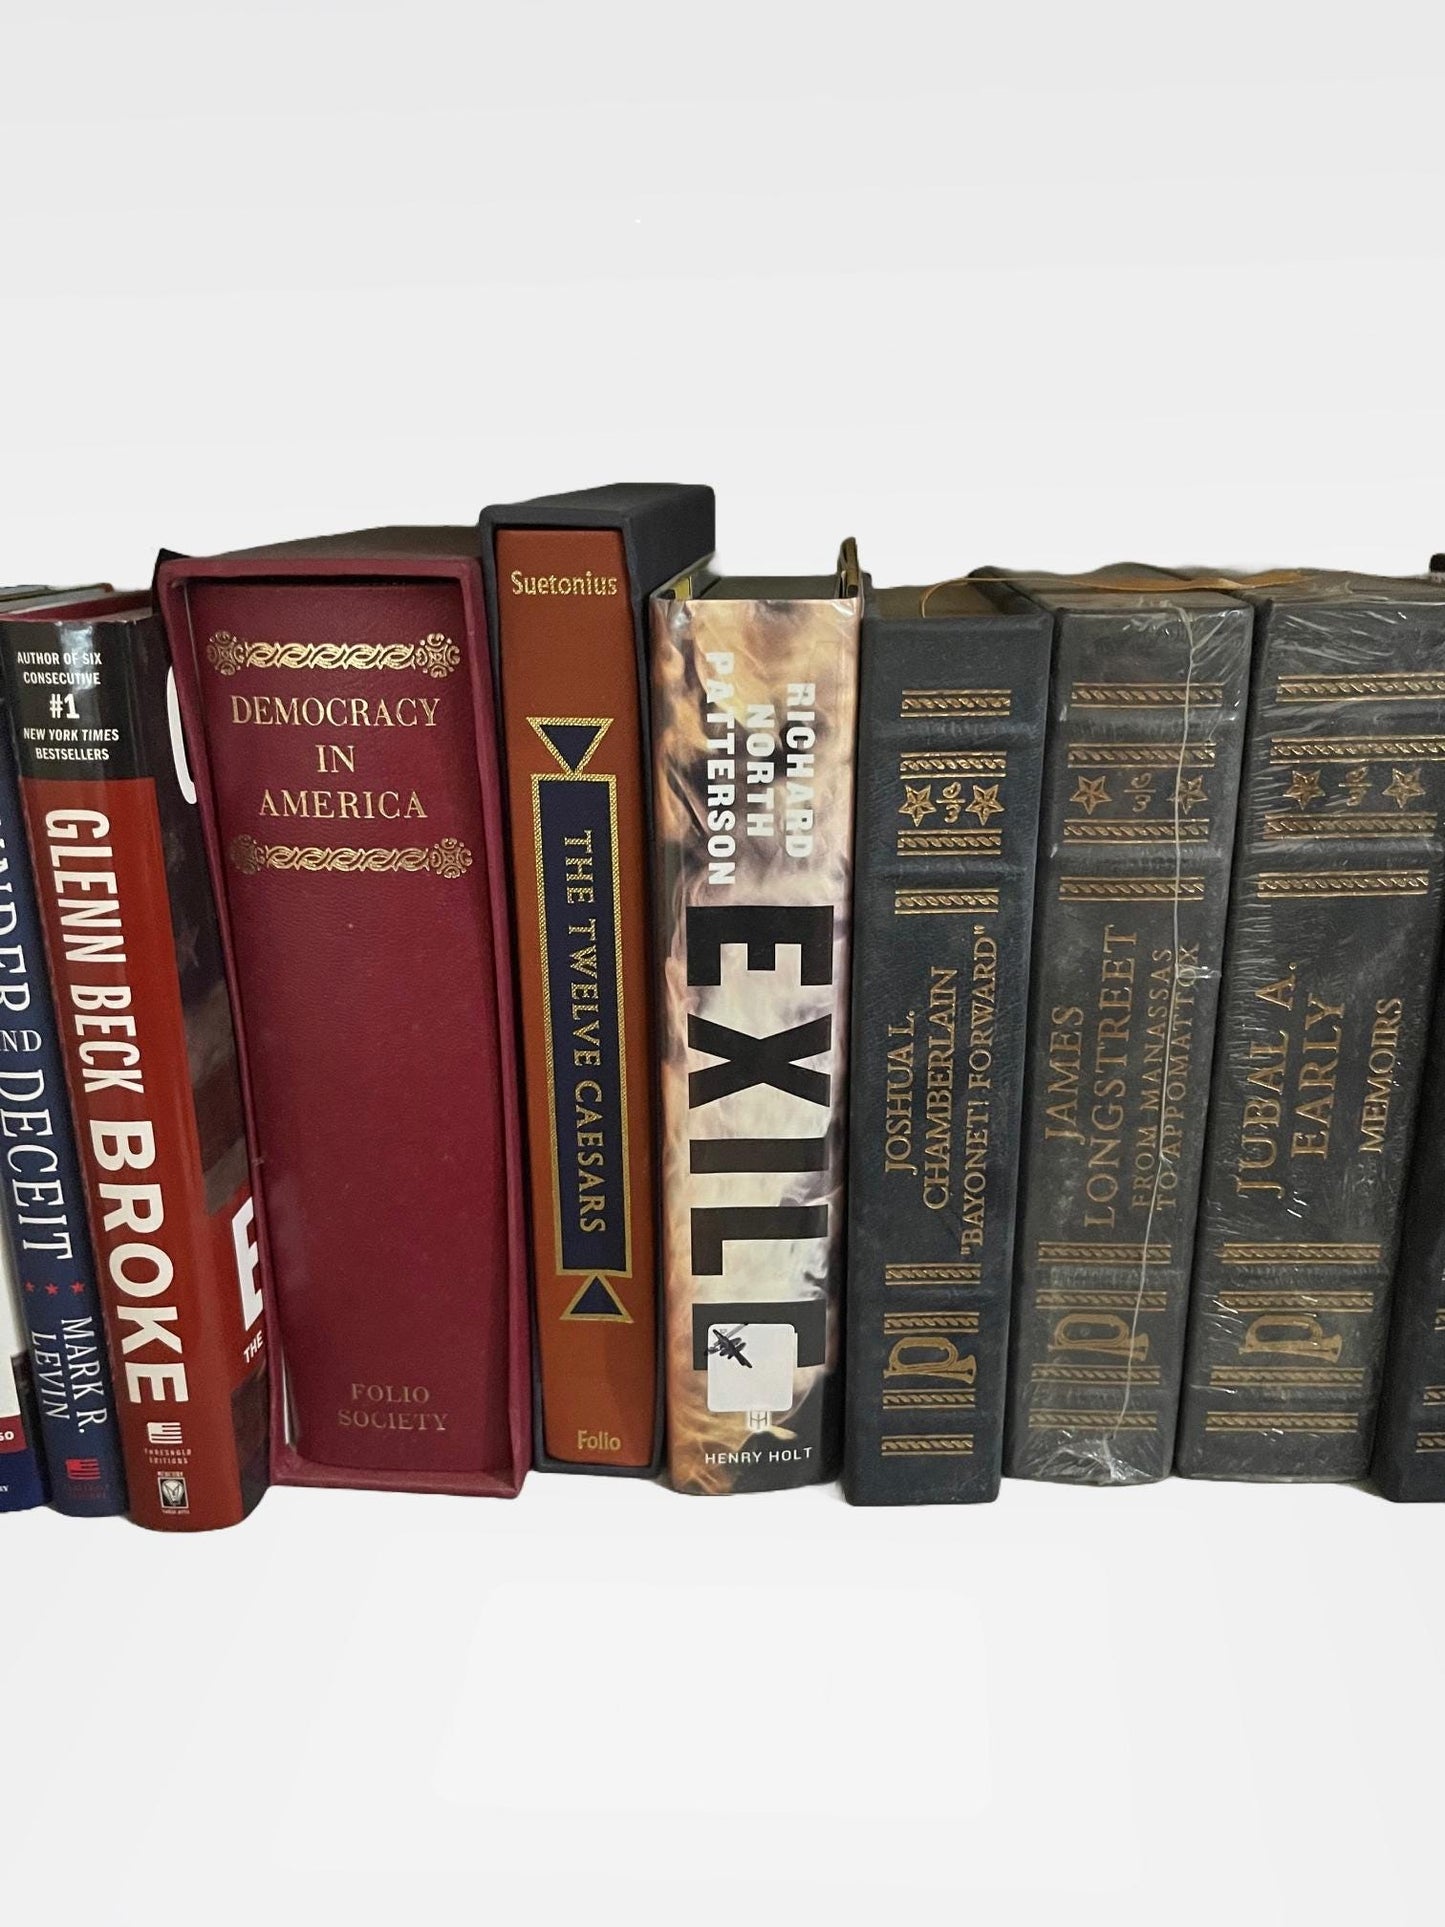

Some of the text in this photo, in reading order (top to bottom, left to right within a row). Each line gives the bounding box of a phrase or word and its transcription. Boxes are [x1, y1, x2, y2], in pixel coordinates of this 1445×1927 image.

[511, 570, 618, 595] Suetonius
[17, 651, 102, 665] AUTHOR OF SIX
[23, 671, 101, 685] CONSECUTIVE
[49, 694, 80, 719] #1
[231, 695, 440, 727] DEMOCRACY
[23, 728, 120, 741] NEW YORK TIMES
[35, 747, 110, 760] BESTSELLERS
[315, 744, 355, 773] IN
[706, 652, 736, 885] PATTERSON
[746, 704, 775, 837] NORTH
[786, 683, 816, 858] RICHARD
[259, 789, 428, 819] AMERICA
[45, 809, 145, 1093] GLENN BECK
[564, 830, 607, 1233] THE TWELVE CAESARS
[885, 1010, 918, 1176] JOSHUA L.
[923, 966, 958, 1210] CHAMBERLAIN
[1045, 1005, 1086, 1145] JAMES
[1084, 924, 1138, 1229] LONGSTREET
[1132, 949, 1173, 1211] FROM MANASSAS
[1156, 943, 1200, 1211] TO APPOMATTOX
[1236, 961, 1297, 1200] JUBAL A.
[1291, 993, 1345, 1160] EARLY
[1359, 998, 1402, 1154] MEMOIRS
[0, 1069, 73, 1259] DECEIT
[686, 905, 835, 1371] EXILE
[90, 1119, 189, 1404] BROKE
[31, 1331, 70, 1419] LEVIN
[61, 1316, 108, 1434] MARK R.
[244, 1331, 264, 1363] THE
[351, 1383, 430, 1403] FOLIO
[338, 1408, 448, 1431] SOCIETY
[577, 1430, 621, 1450] Folio
[705, 1447, 813, 1465] HENRY HOLT
